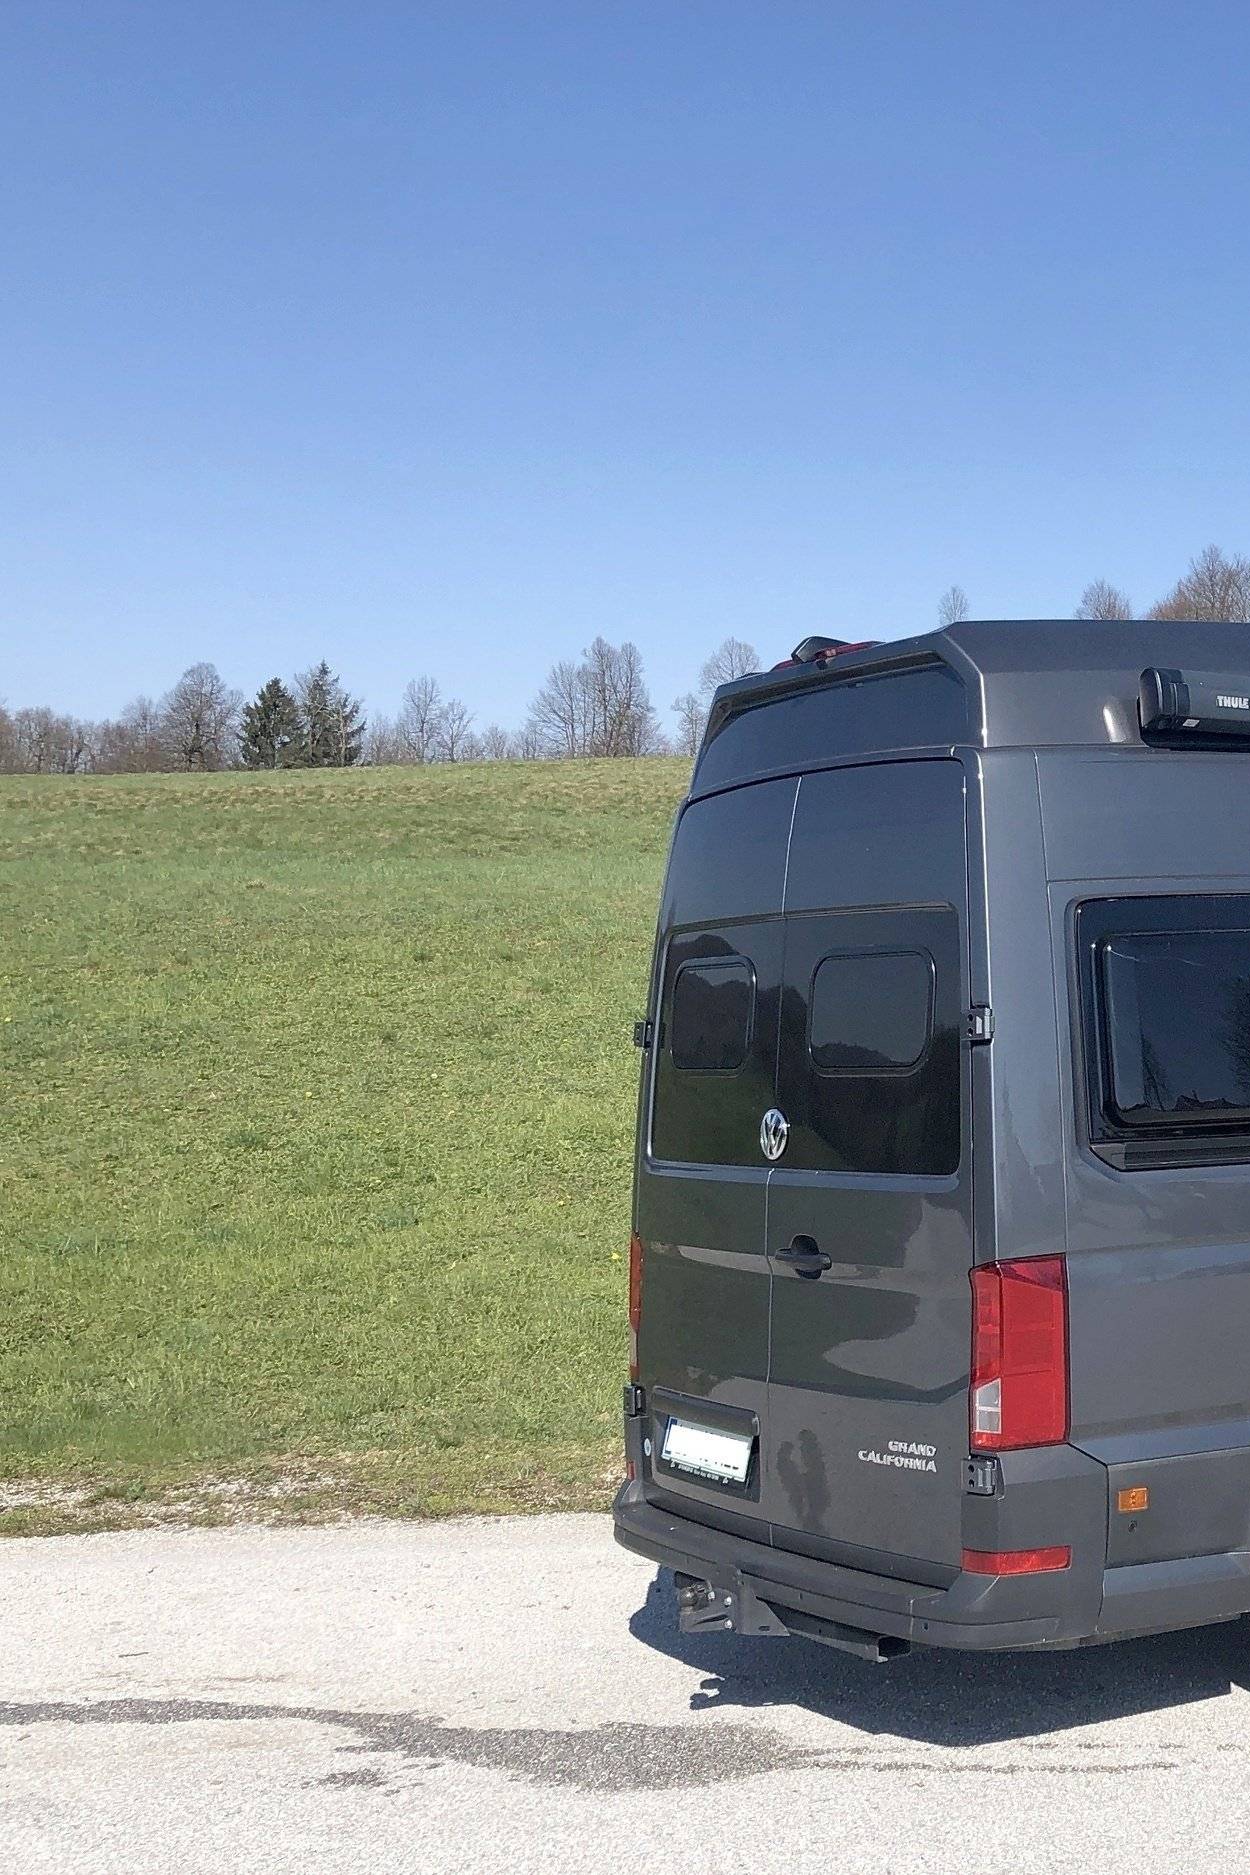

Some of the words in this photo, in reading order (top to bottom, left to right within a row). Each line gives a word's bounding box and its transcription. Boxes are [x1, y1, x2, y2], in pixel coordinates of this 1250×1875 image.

[1216, 695, 1249, 709] THULE
[888, 1441, 937, 1457] GRAND
[858, 1450, 937, 1473] CALIFORNIA
